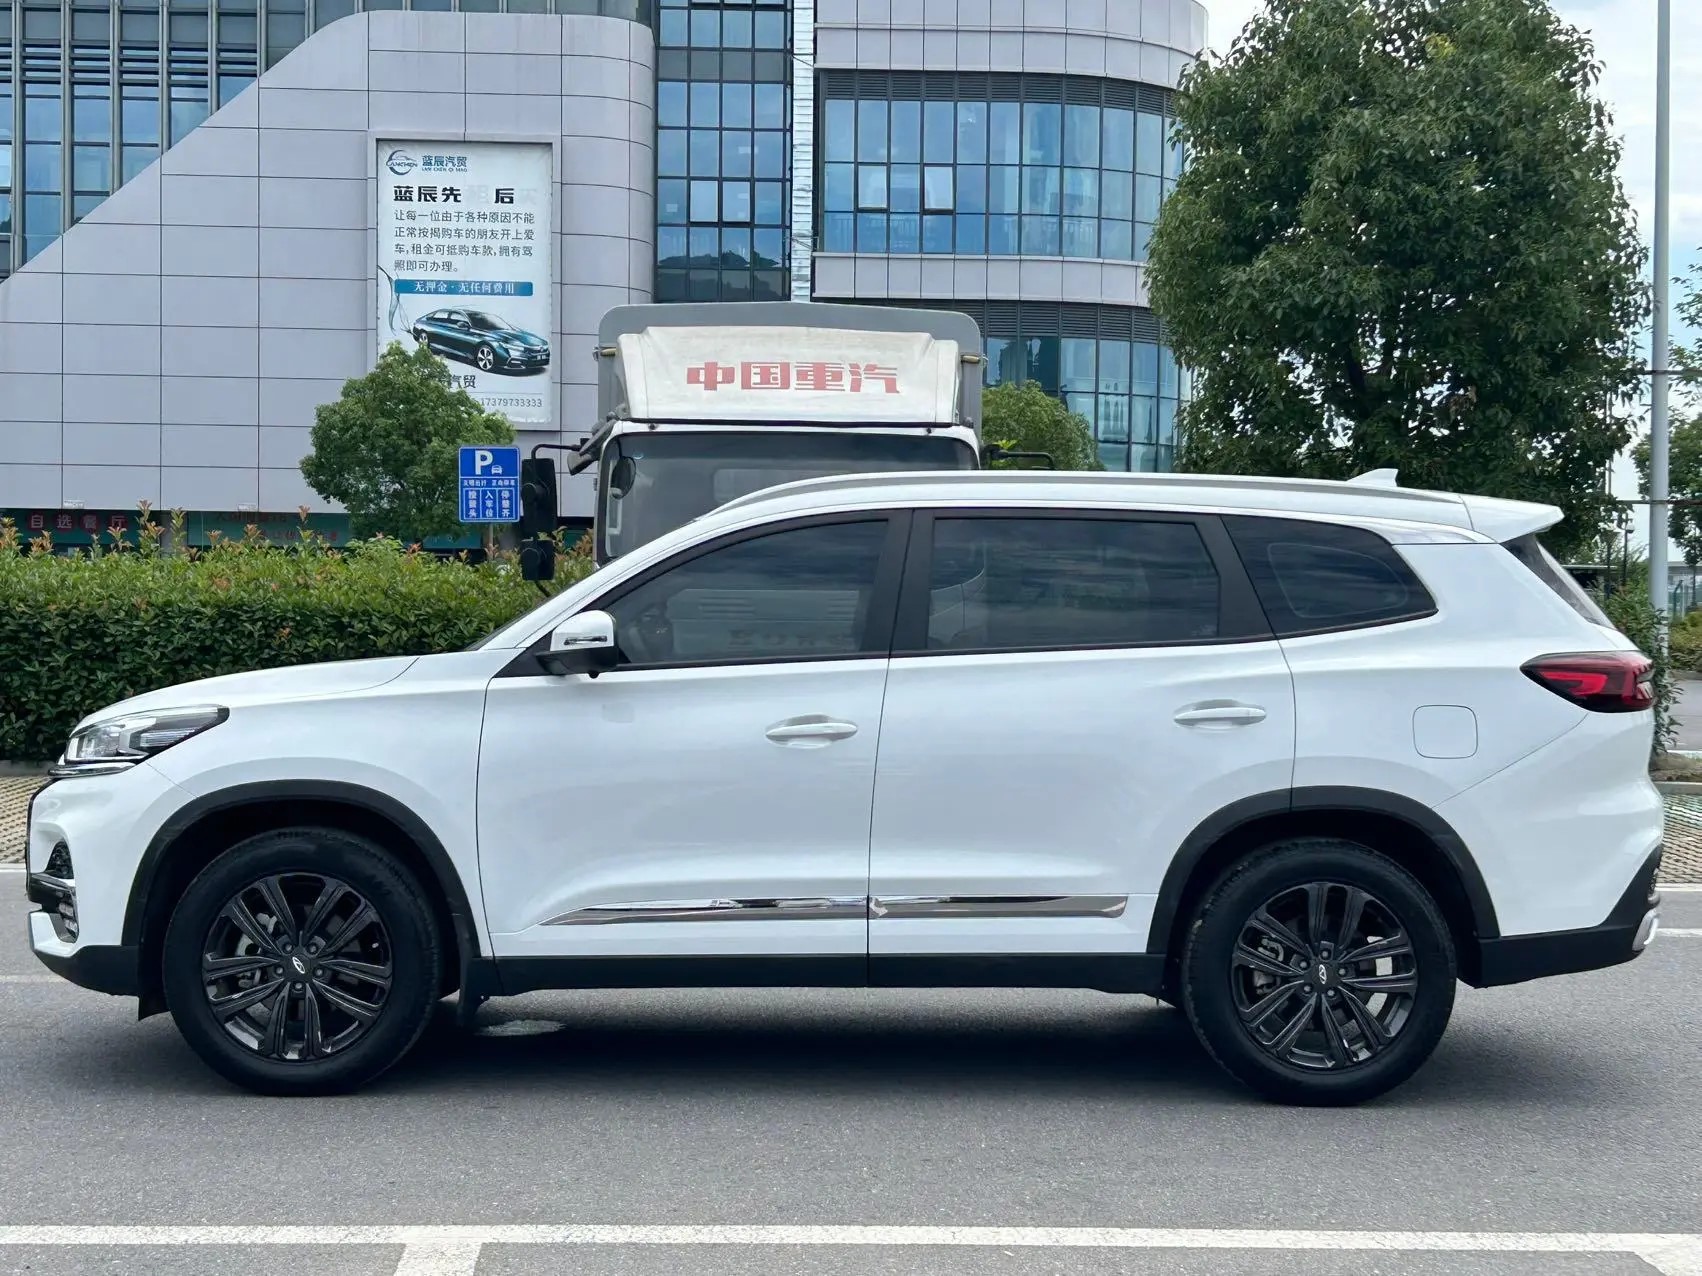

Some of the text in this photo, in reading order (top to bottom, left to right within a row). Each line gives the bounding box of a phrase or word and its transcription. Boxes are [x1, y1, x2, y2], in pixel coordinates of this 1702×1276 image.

[421, 155, 468, 167] 蓝辰汽贸
[394, 210, 535, 224] 让每一位由于各种原因不能
[394, 227, 535, 241] 正常按揭购车的朋友开上爱
[687, 361, 900, 393] 中国重汽
[480, 397, 543, 408] 17379733333
[475, 450, 493, 475] P
